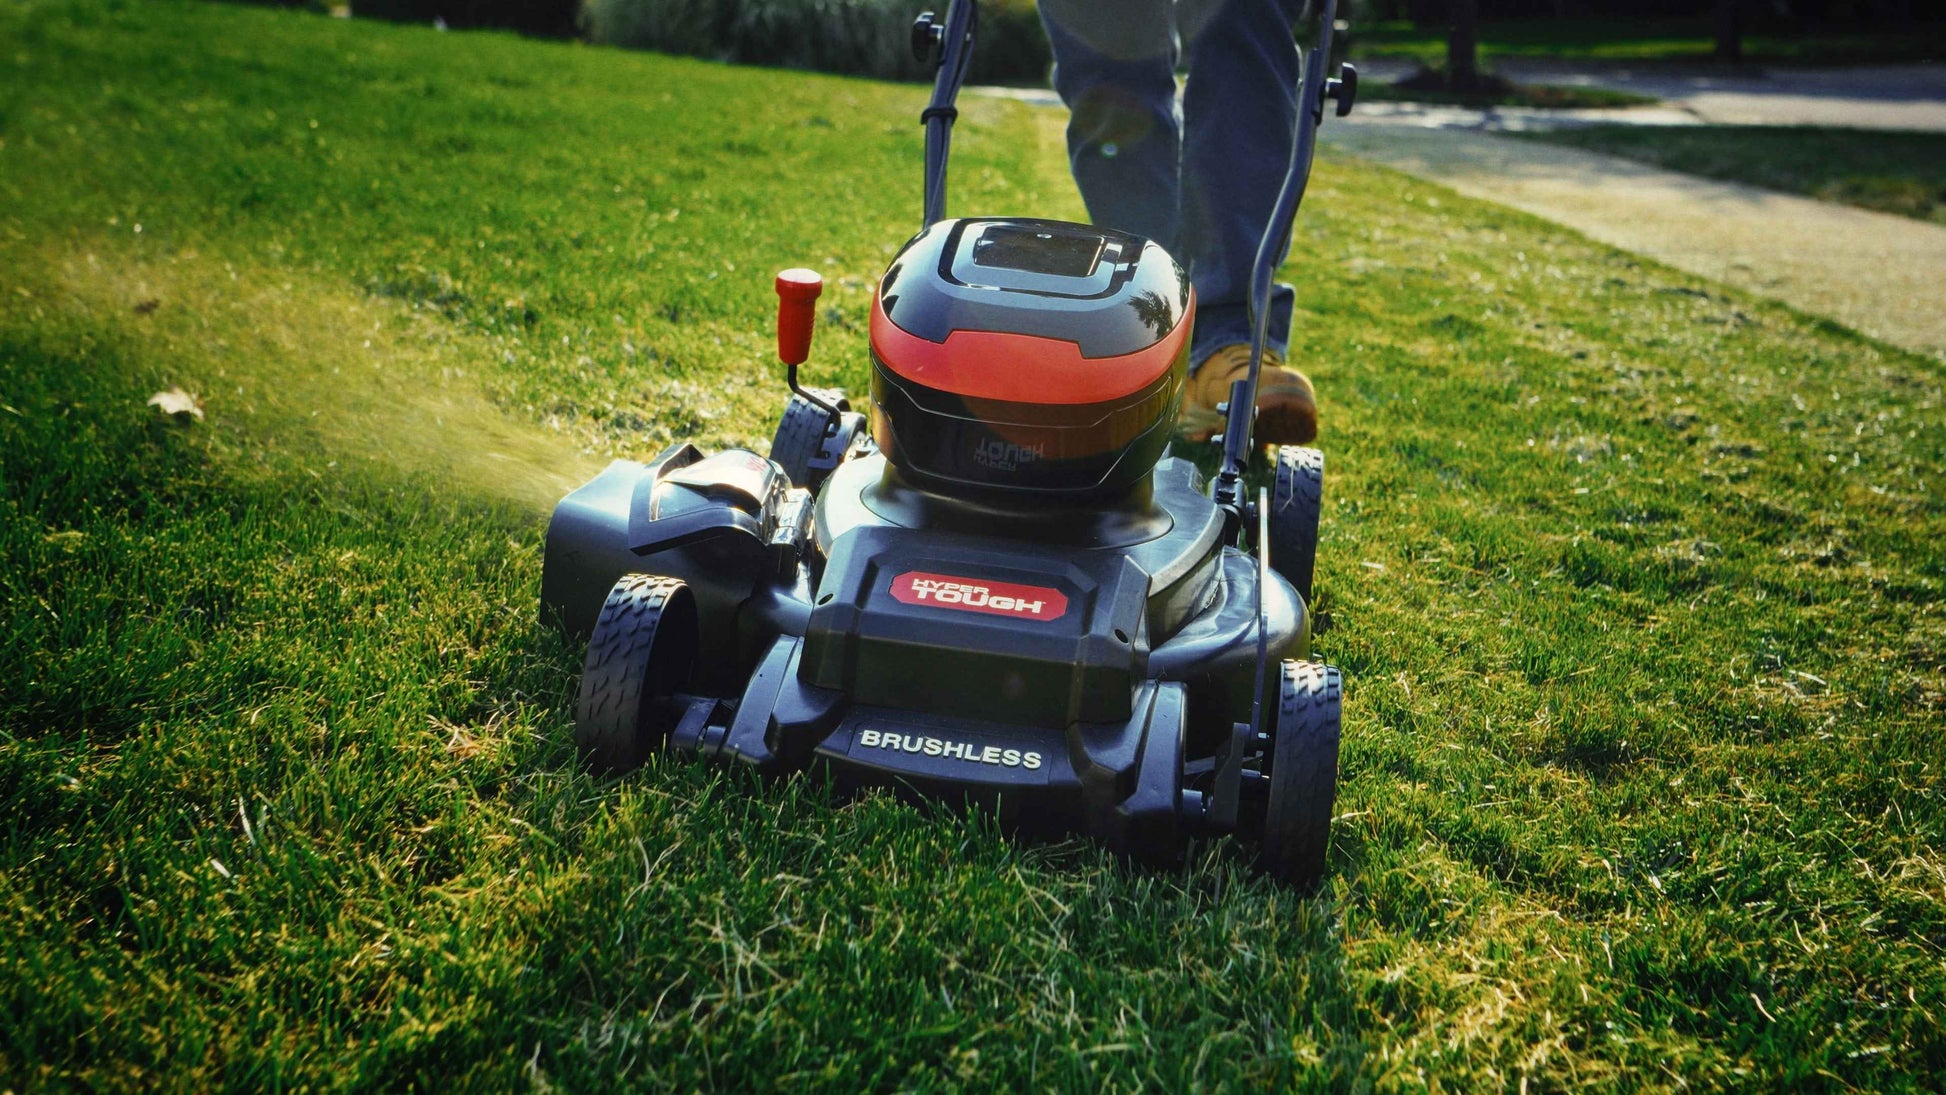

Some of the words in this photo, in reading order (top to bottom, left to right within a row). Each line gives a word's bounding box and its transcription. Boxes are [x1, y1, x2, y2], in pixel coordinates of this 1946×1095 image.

[911, 585, 1043, 614] TOUGH
[912, 578, 989, 595] HYPER
[860, 730, 1042, 769] BRUSHLESS
